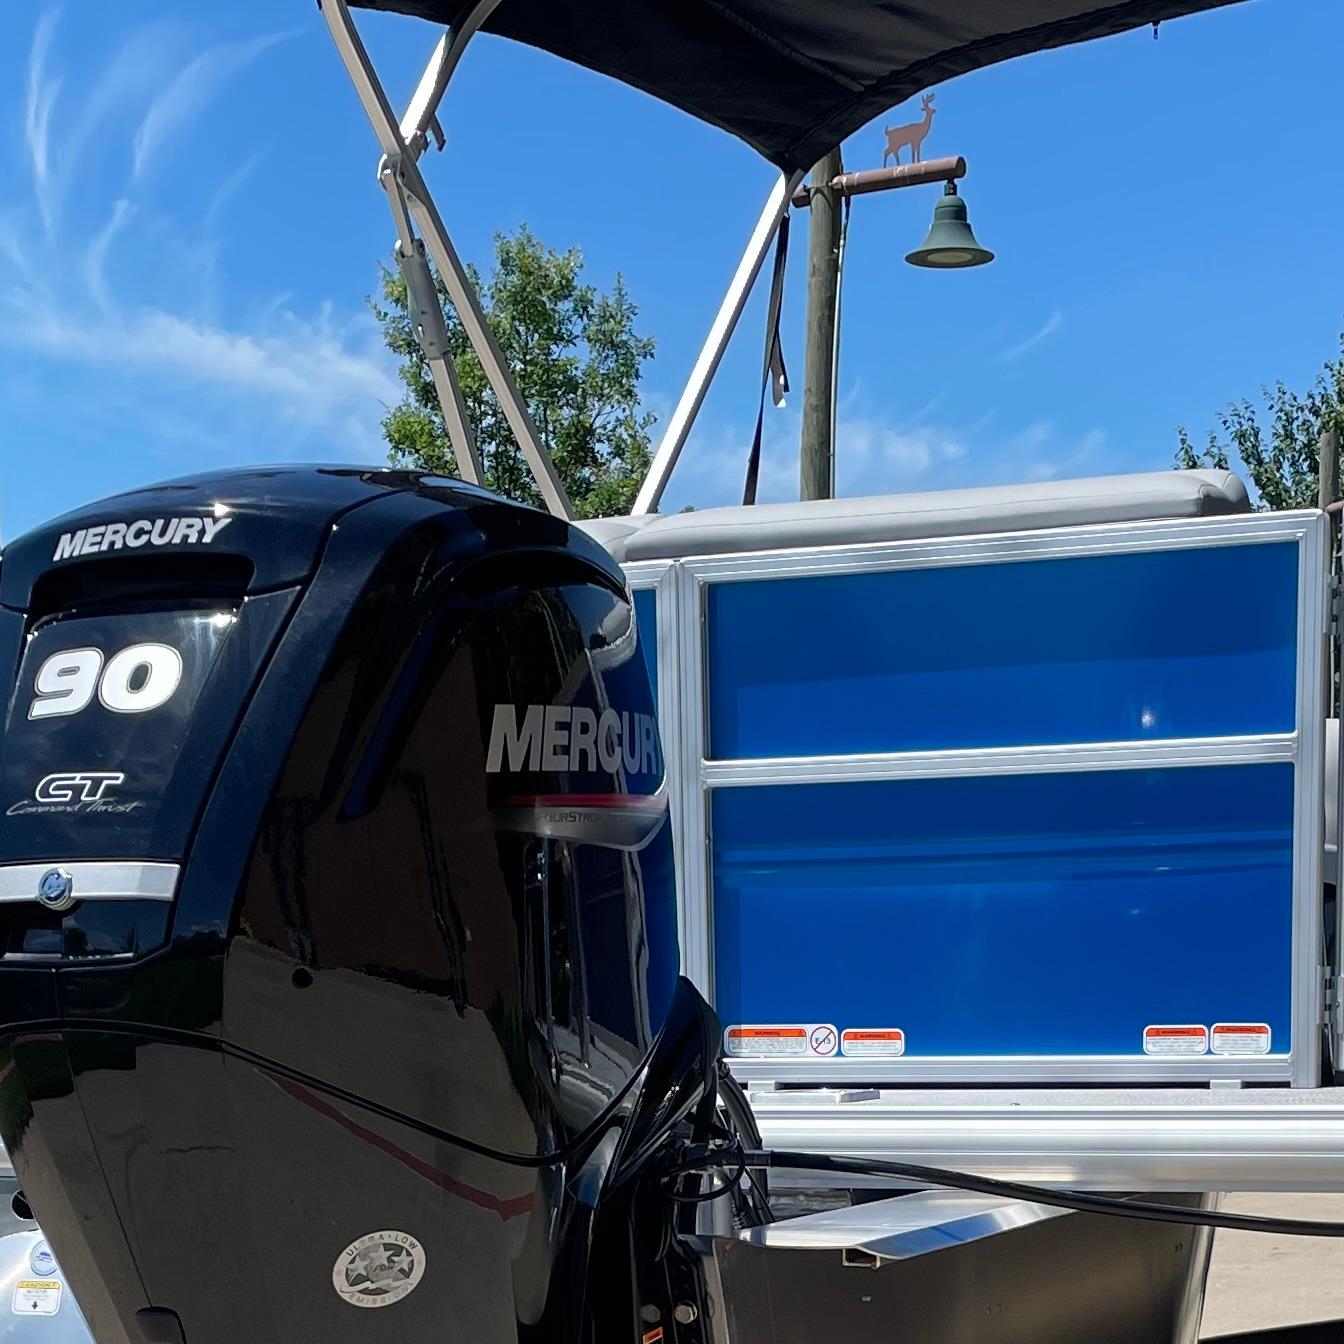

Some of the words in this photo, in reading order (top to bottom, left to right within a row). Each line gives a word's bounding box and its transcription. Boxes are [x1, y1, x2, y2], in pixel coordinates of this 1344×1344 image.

[52, 517, 232, 562] MERCURY
[28, 642, 183, 721] 90
[485, 703, 663, 775] MERCUR
[394, 1234, 419, 1250] LOW
